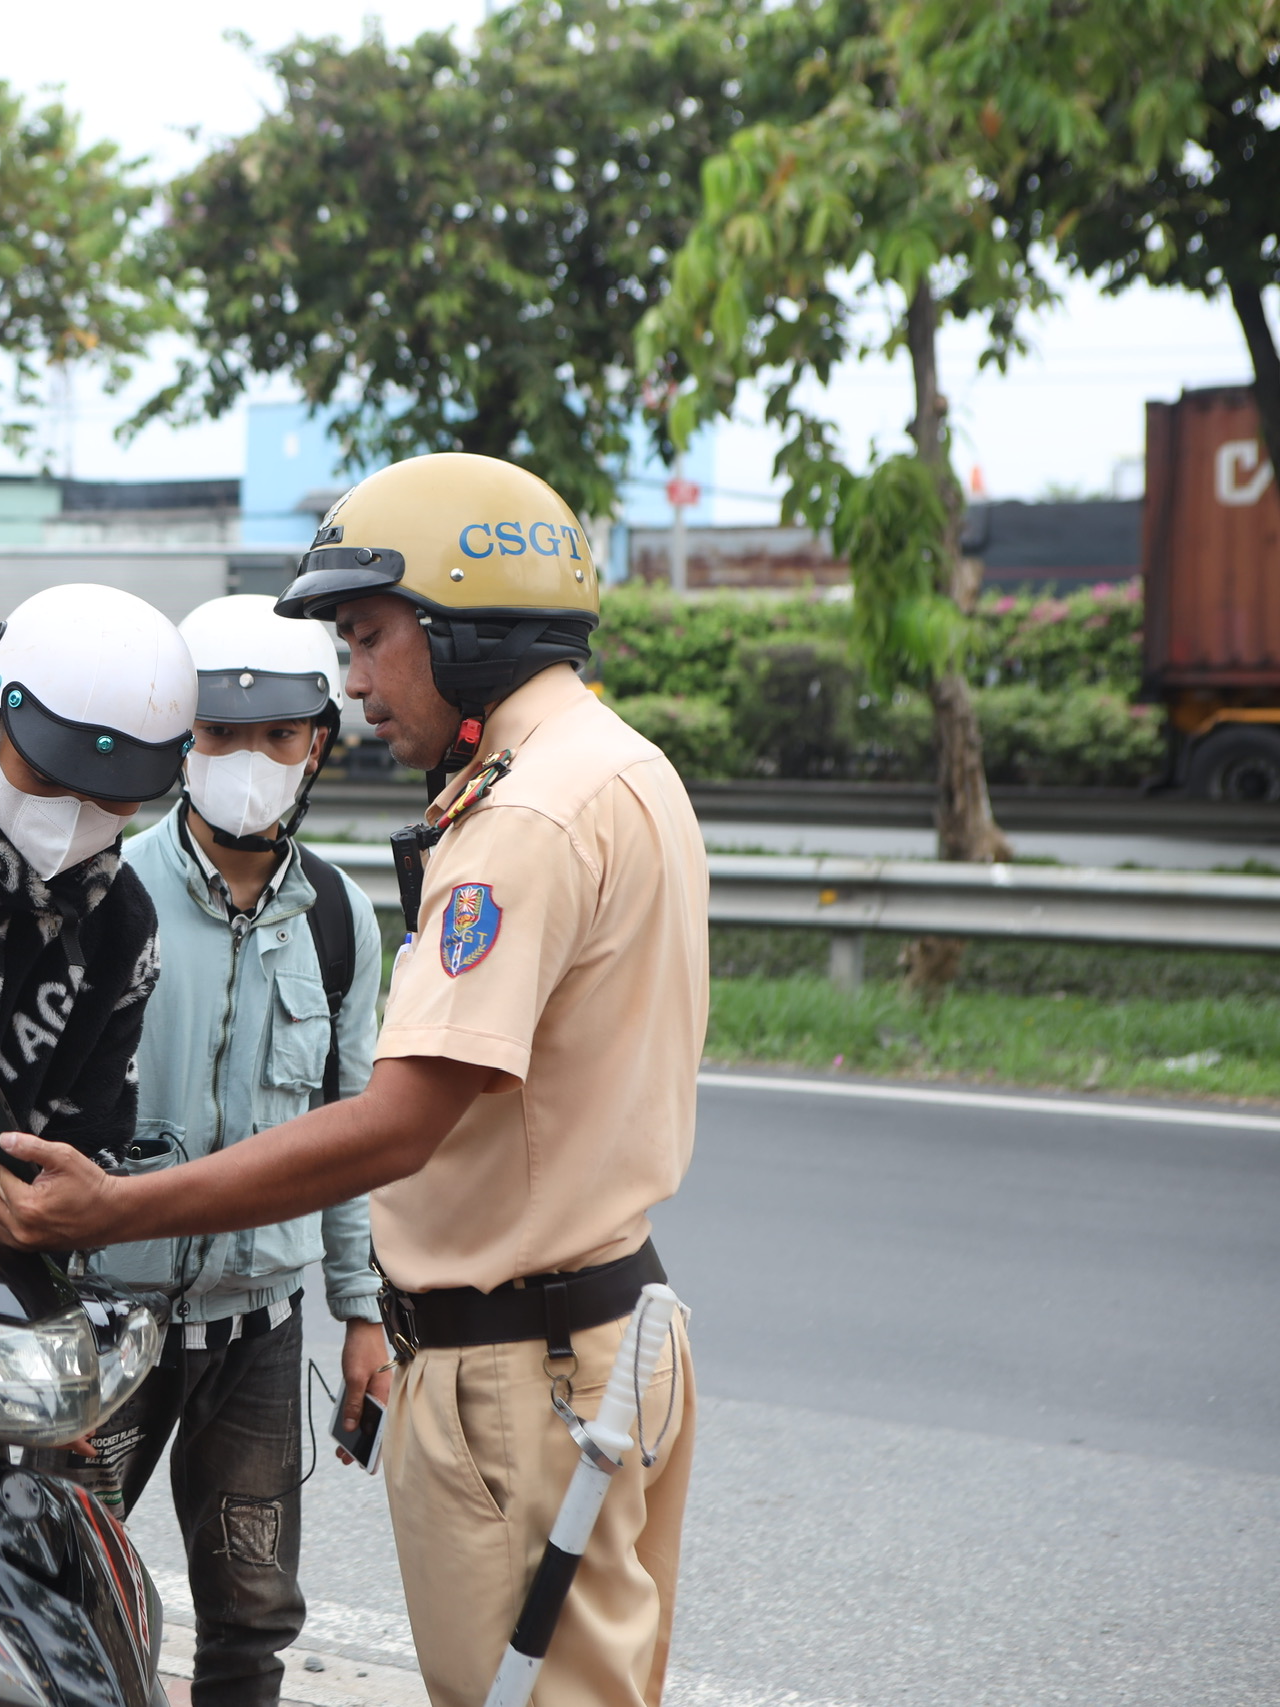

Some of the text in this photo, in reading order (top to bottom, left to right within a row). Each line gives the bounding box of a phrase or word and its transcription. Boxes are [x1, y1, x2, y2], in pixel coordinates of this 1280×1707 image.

[459, 521, 582, 560] CSGT
[444, 929, 488, 948] CSGT
[90, 1433, 120, 1448] ROCKET
